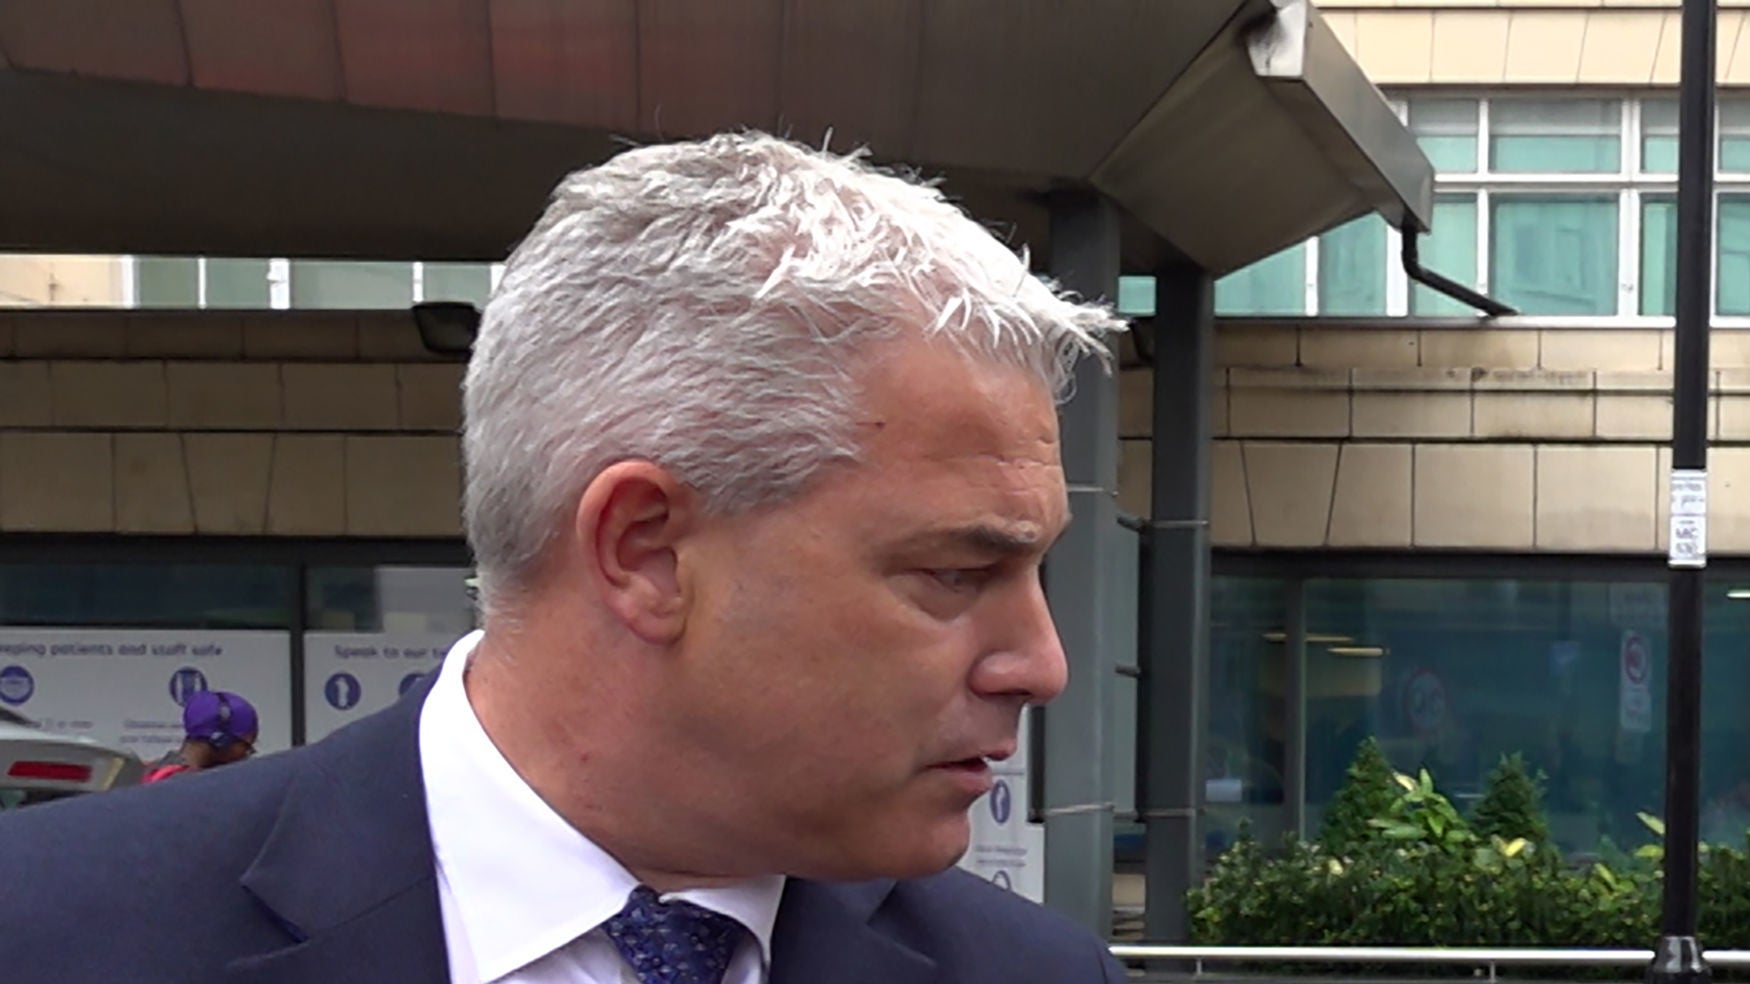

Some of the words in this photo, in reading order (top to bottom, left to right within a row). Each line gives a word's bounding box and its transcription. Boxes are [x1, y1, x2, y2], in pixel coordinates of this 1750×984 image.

[51, 643, 112, 656] patients
[118, 643, 147, 655] and
[152, 643, 187, 655] staff
